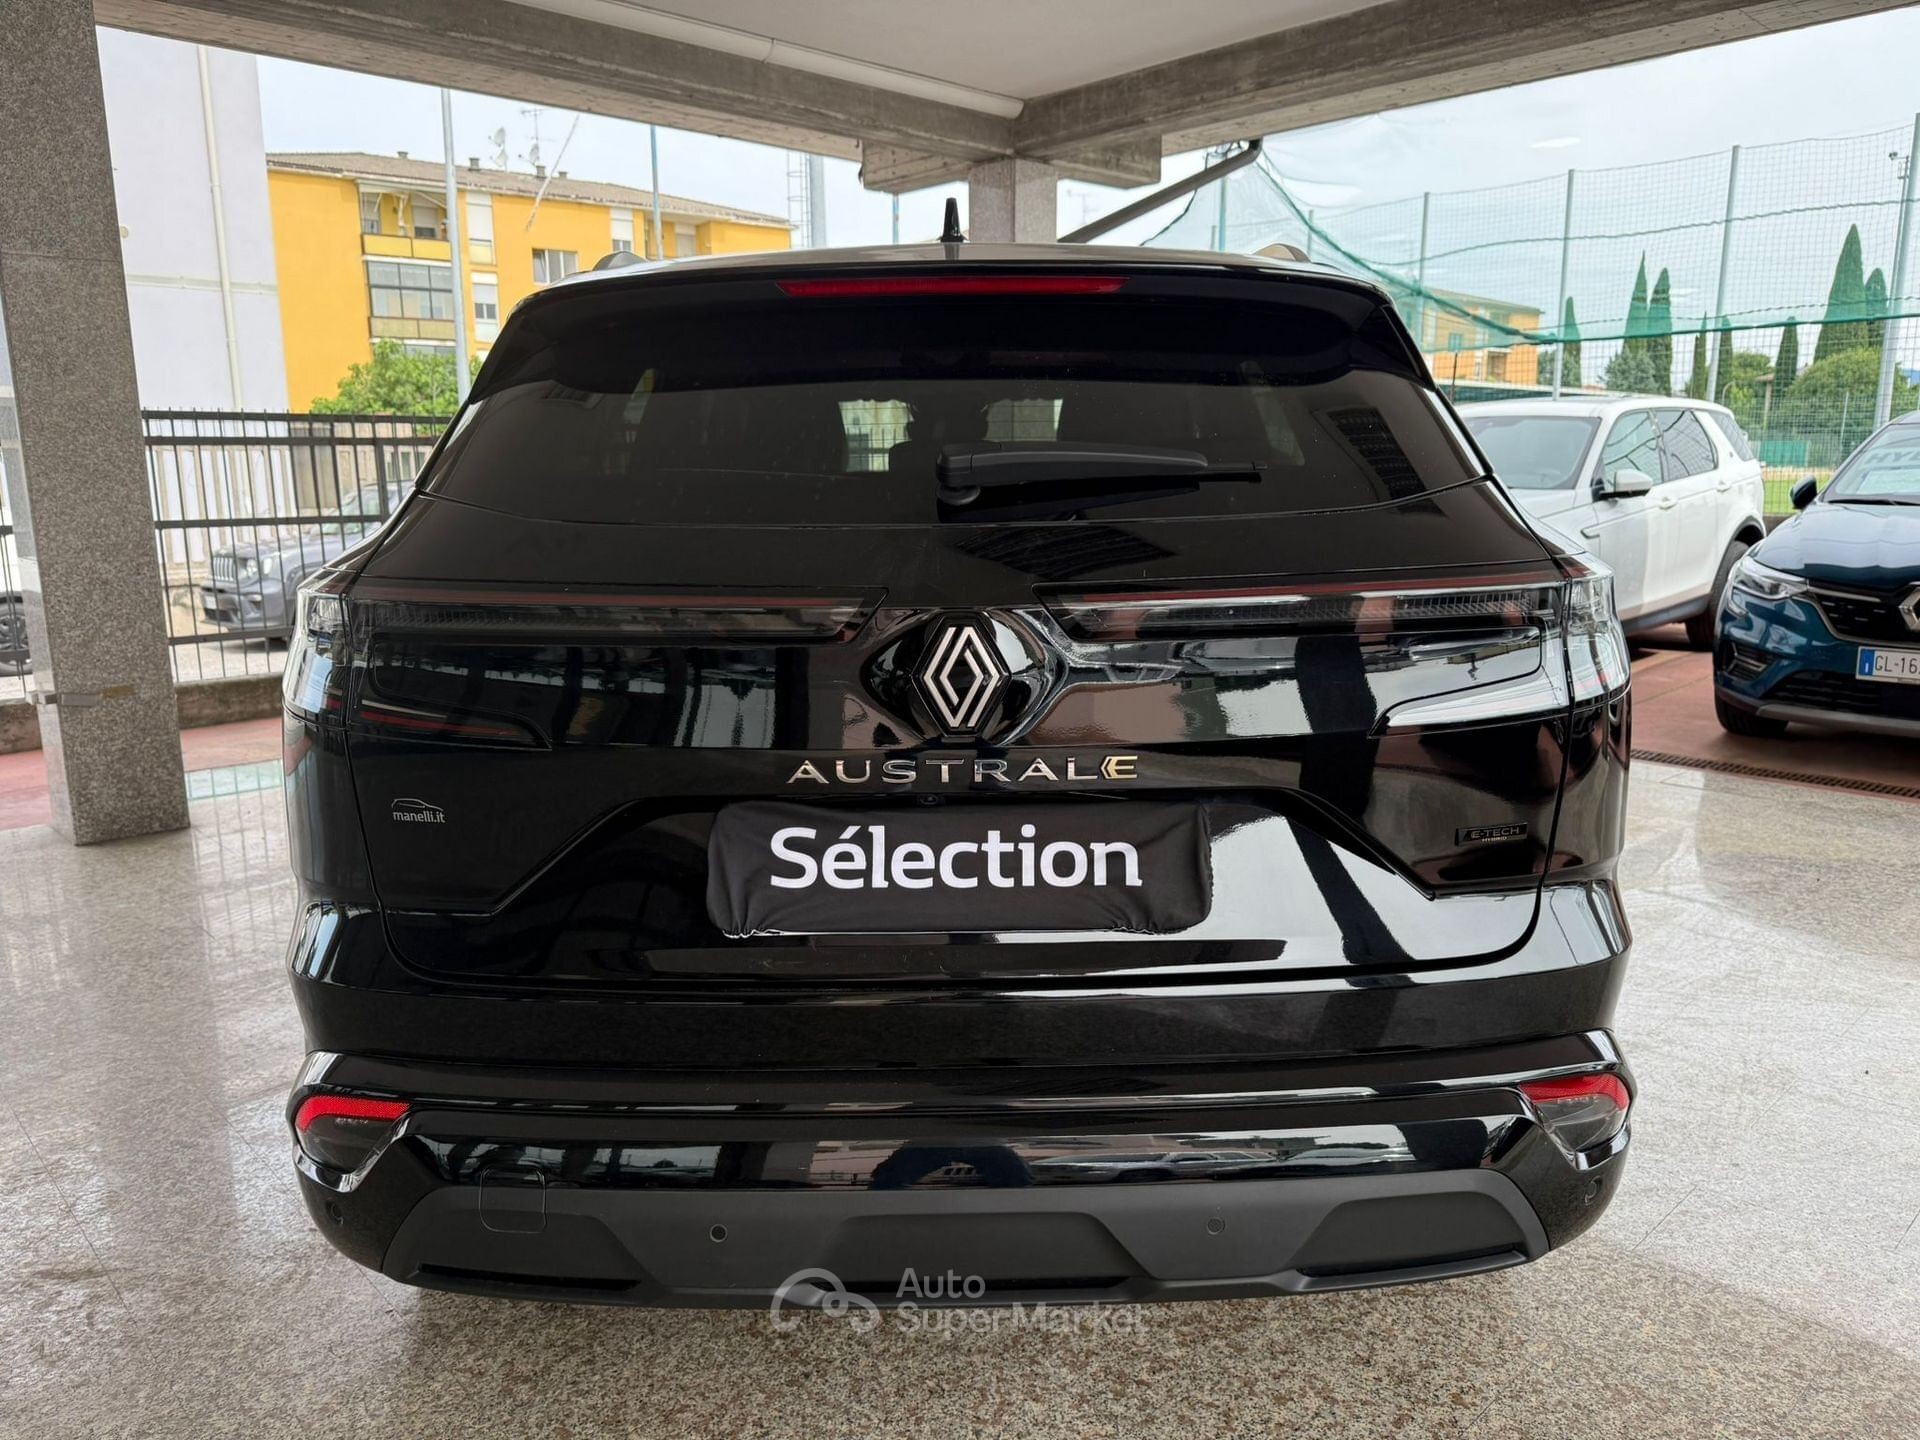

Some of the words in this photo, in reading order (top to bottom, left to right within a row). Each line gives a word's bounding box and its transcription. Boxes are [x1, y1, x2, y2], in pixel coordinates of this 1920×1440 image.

[788, 756, 1139, 784] AUSTRALE
[392, 811, 446, 823] manelli.it
[1471, 826, 1520, 839] E-TECH
[770, 824, 1143, 889] Sélection
